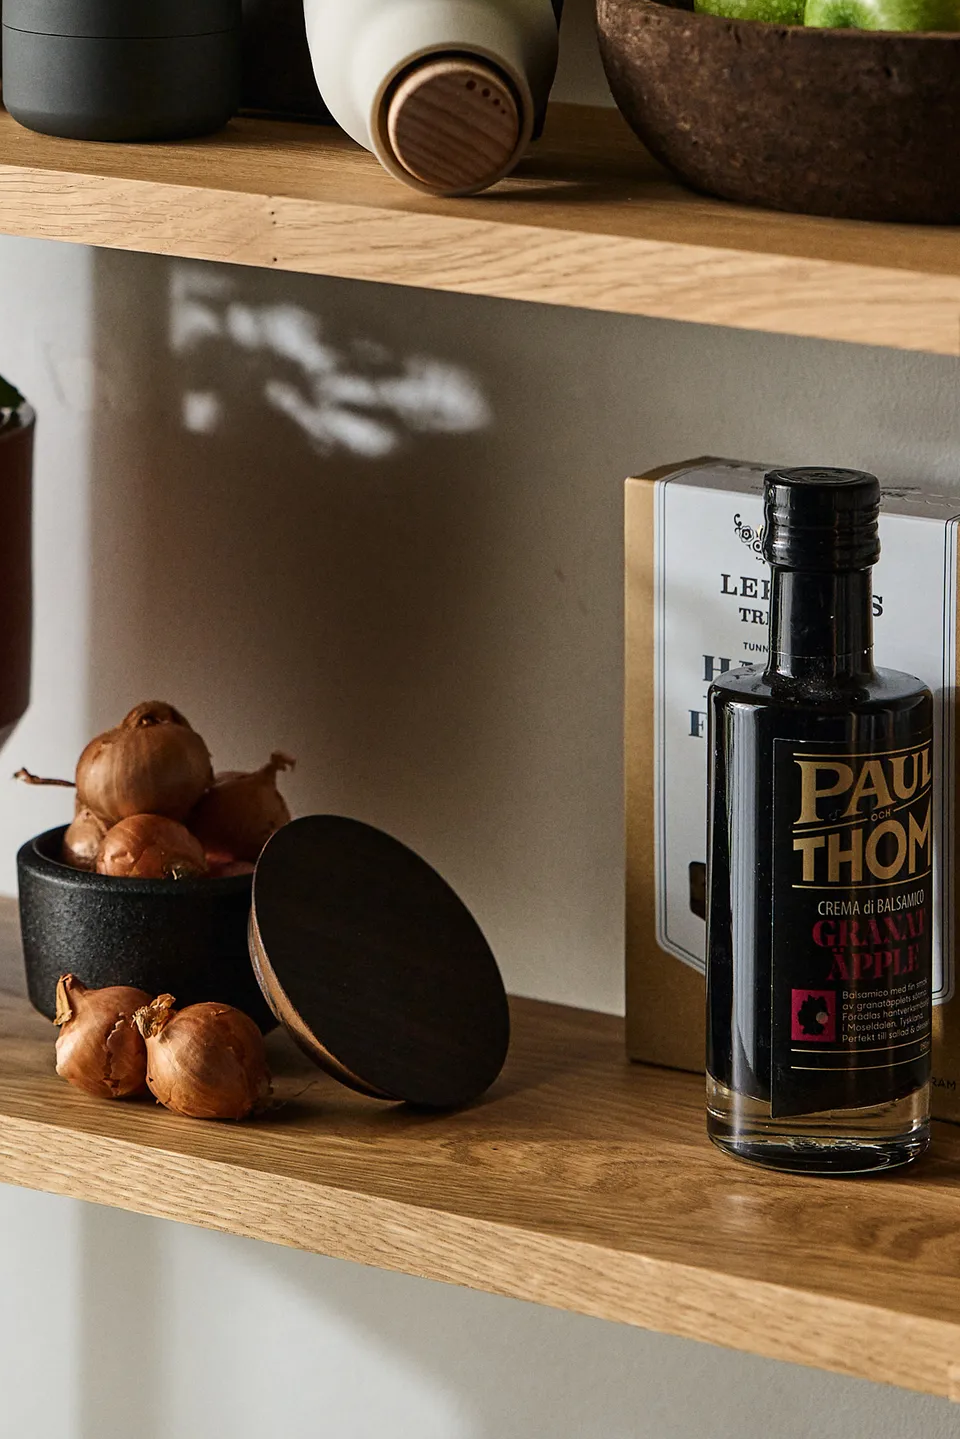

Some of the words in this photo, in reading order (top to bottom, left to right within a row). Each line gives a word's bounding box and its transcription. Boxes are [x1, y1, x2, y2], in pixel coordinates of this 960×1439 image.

[793, 747, 931, 825] PAUL
[871, 809, 891, 822] OCH
[817, 900, 860, 916] CREMA
[863, 900, 874, 914] di
[877, 889, 924, 914] BALSAMICO
[826, 943, 919, 980] ÄPPLE
[842, 989, 888, 1000] Balsamico
[890, 984, 907, 996] med
[842, 1002, 854, 1010] av
[842, 1033, 875, 1043] Perfekt
[888, 1029, 909, 1039] sallad
[910, 1026, 915, 1034] &
